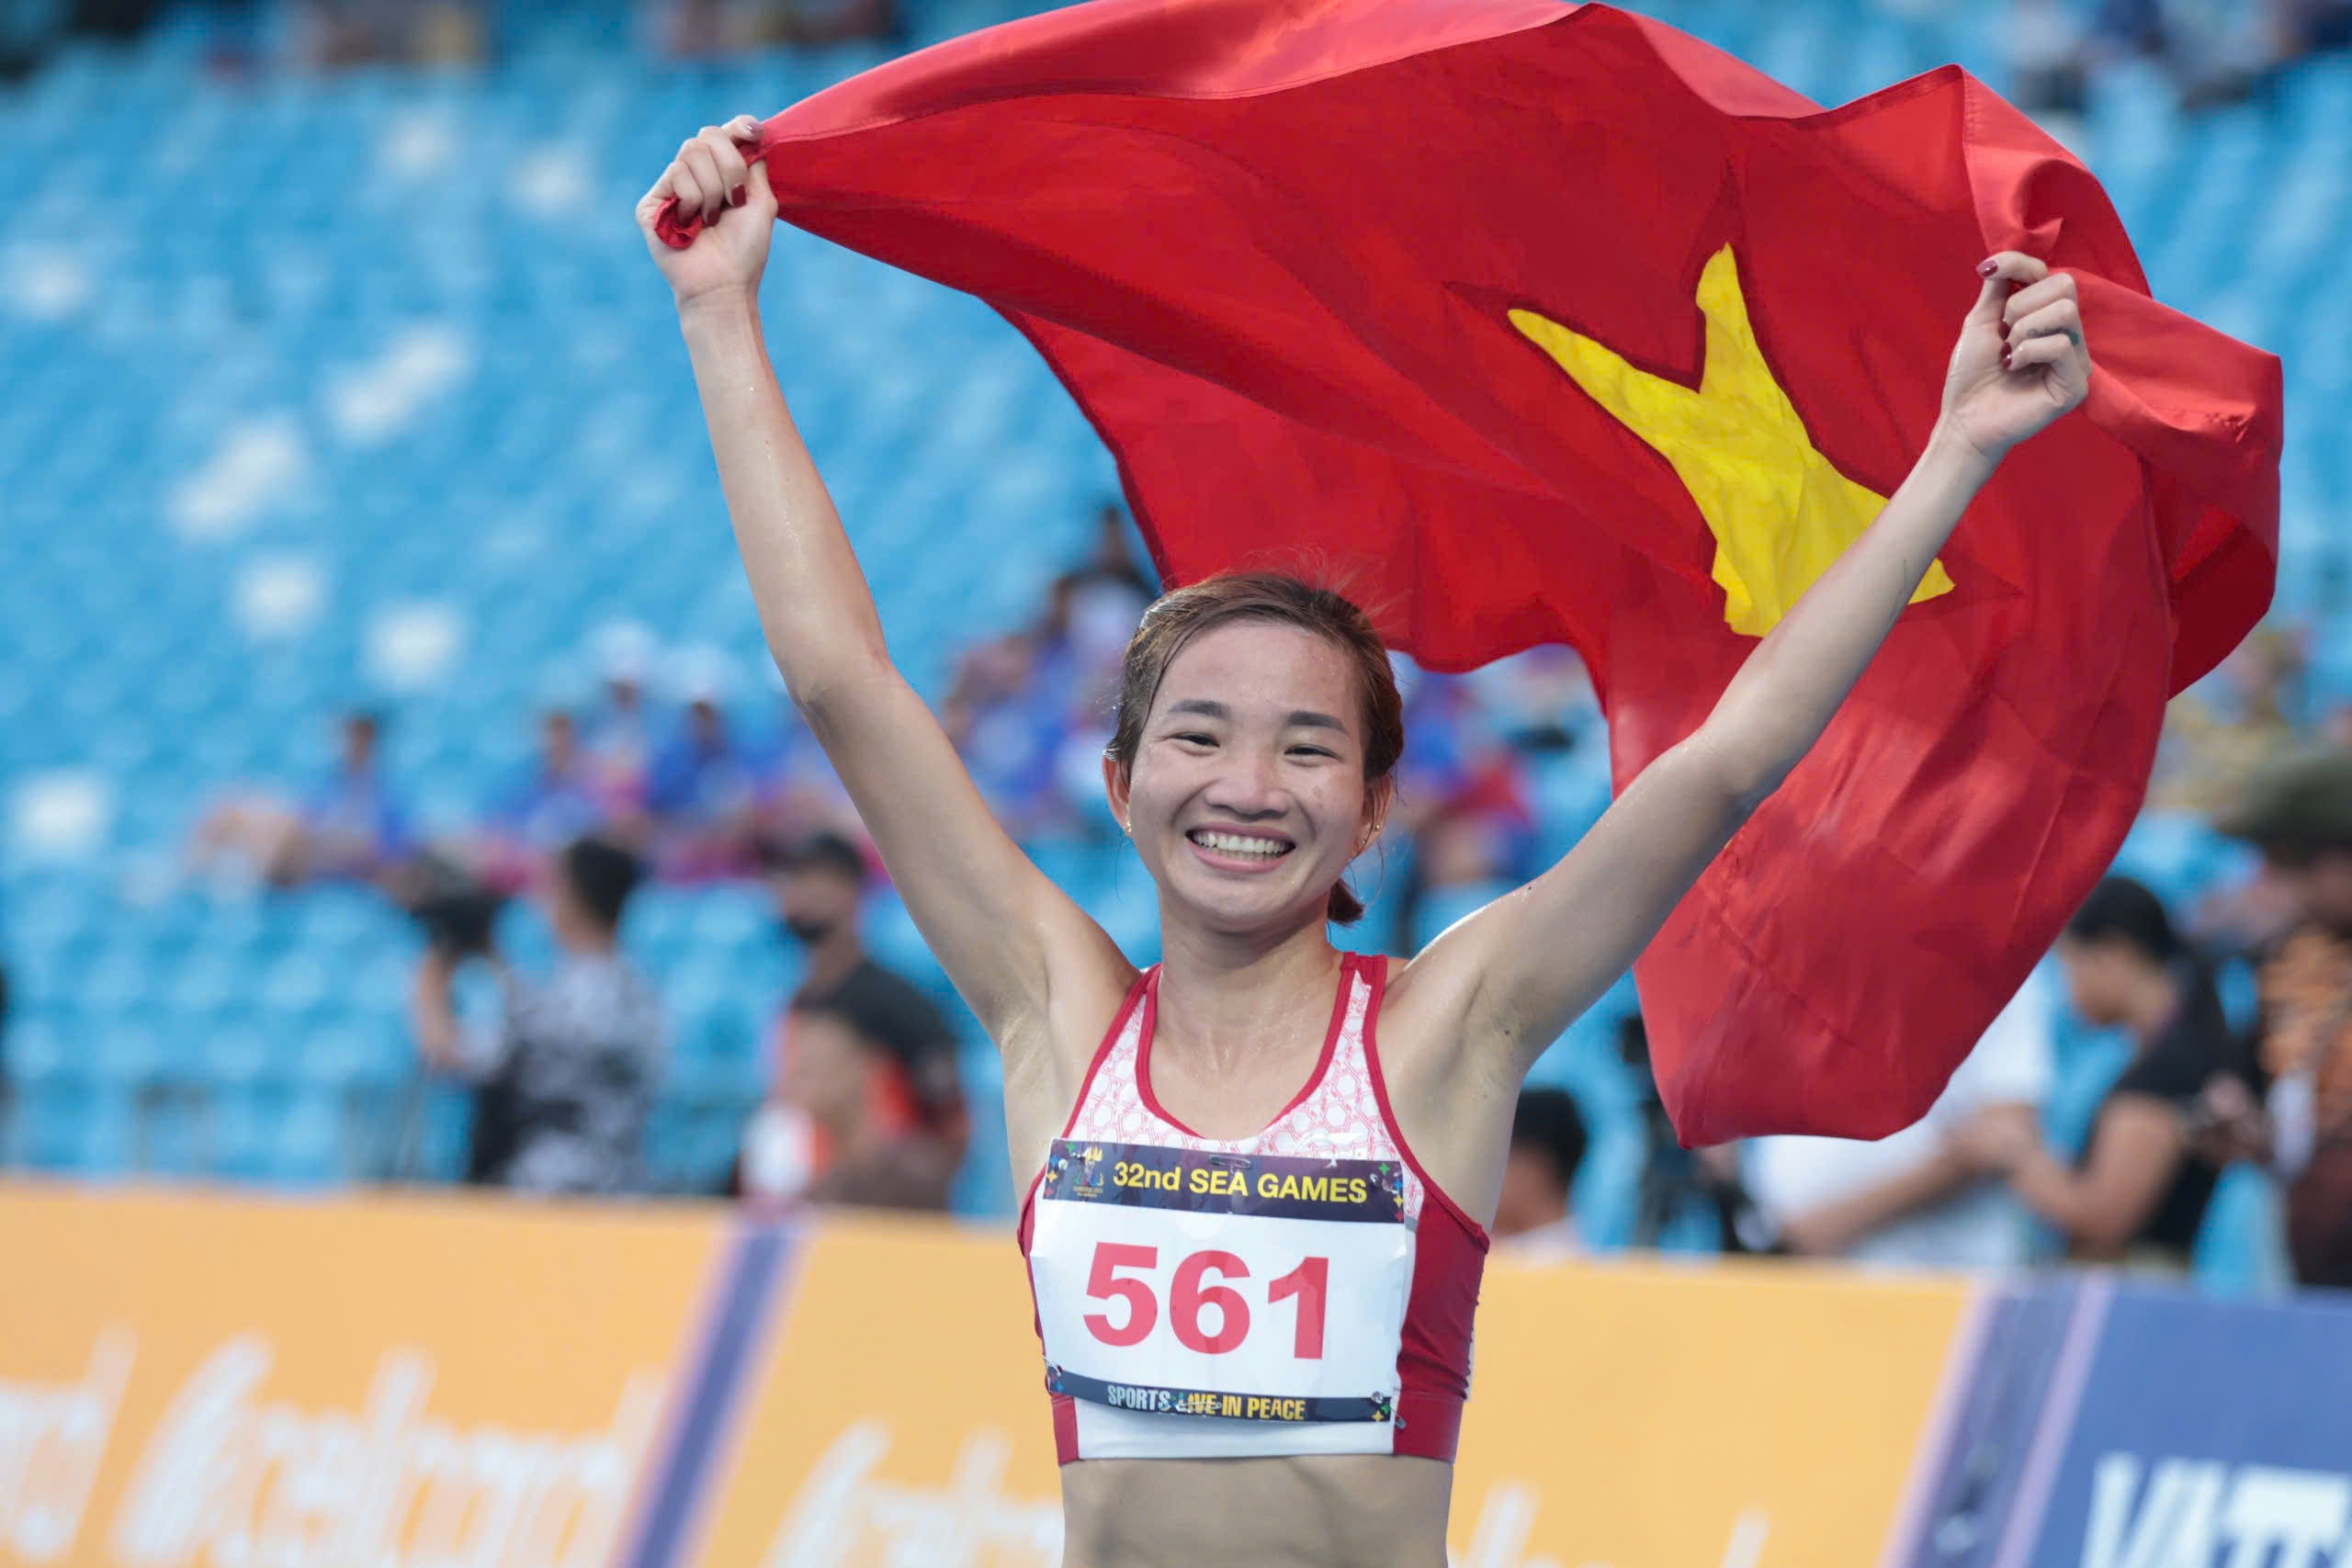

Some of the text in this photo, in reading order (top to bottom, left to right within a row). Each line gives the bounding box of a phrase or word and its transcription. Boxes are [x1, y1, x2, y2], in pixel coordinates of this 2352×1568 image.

[1113, 1162, 1367, 1203] 32nd SEA GAMES
[1082, 1241, 1329, 1360] 561
[1107, 1384, 1171, 1412] SPORTS
[1221, 1395, 1242, 1416] IN
[1247, 1397, 1306, 1420] PEACE
